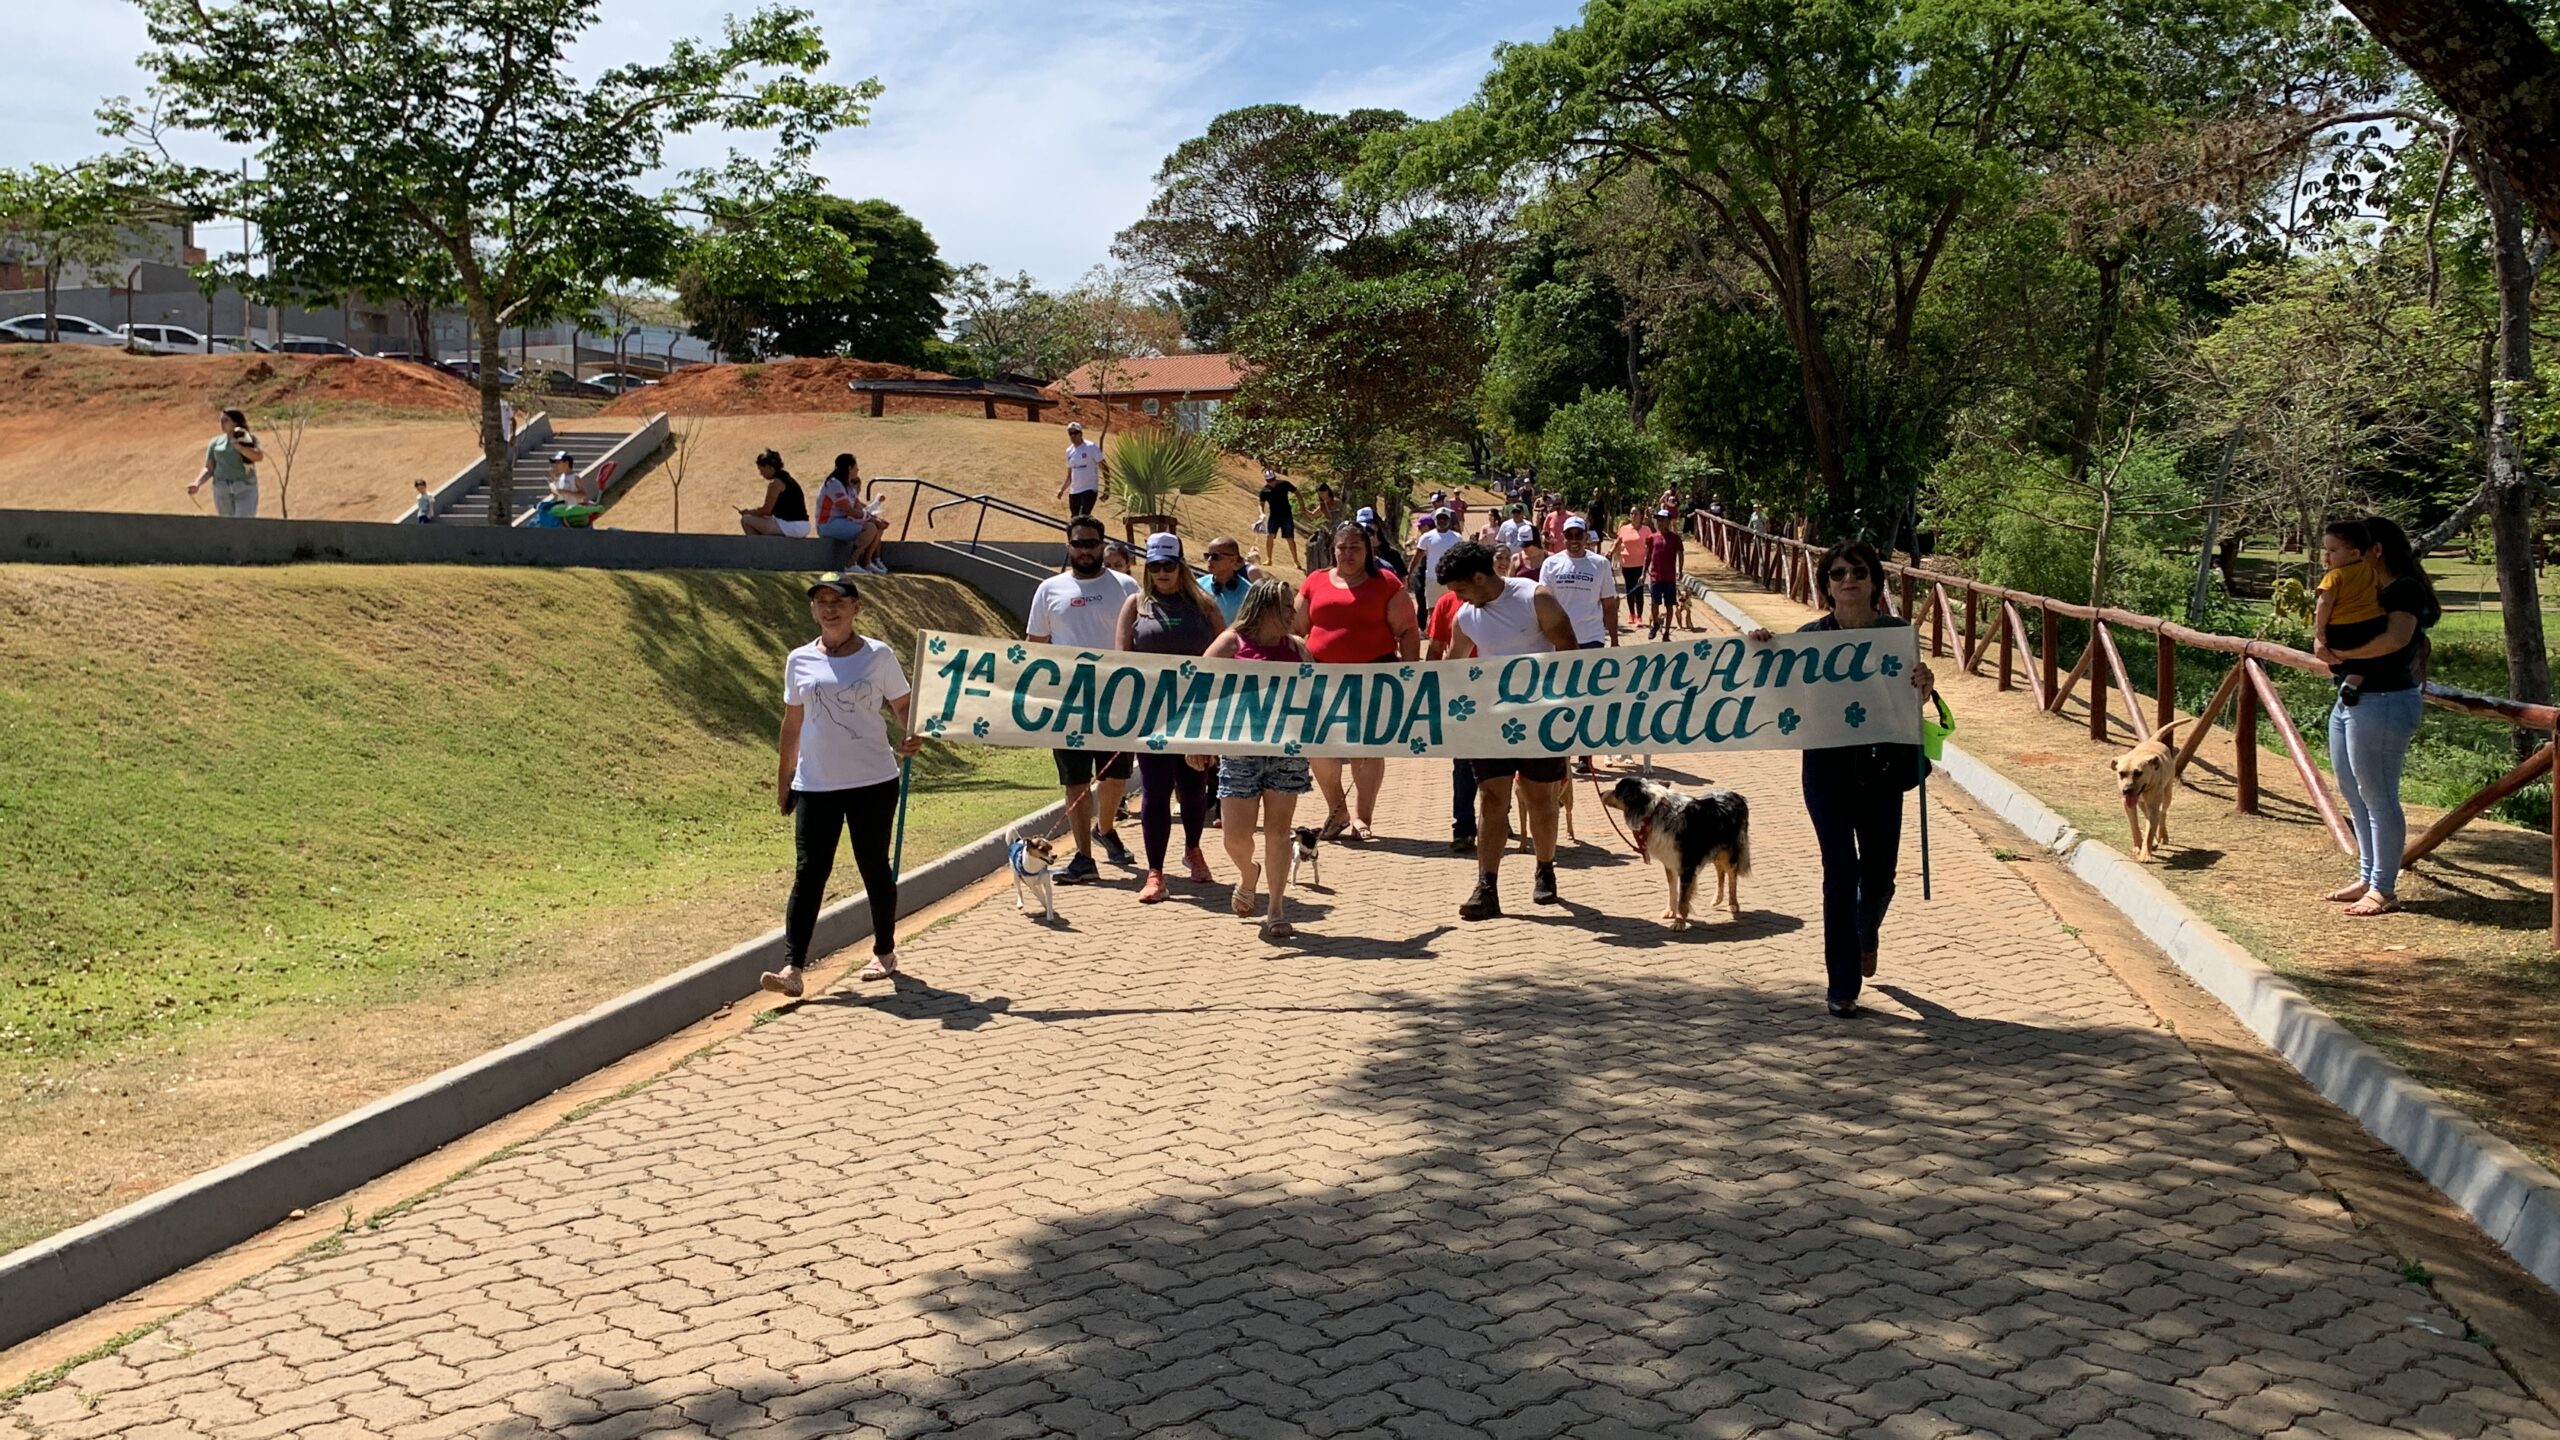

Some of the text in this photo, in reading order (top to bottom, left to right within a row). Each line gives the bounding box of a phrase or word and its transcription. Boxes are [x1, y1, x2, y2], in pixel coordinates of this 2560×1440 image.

[1011, 652, 1445, 746] CÃOMINHADA
[1494, 637, 1876, 706] Quem Ama
[1537, 685, 1775, 753] cuida
